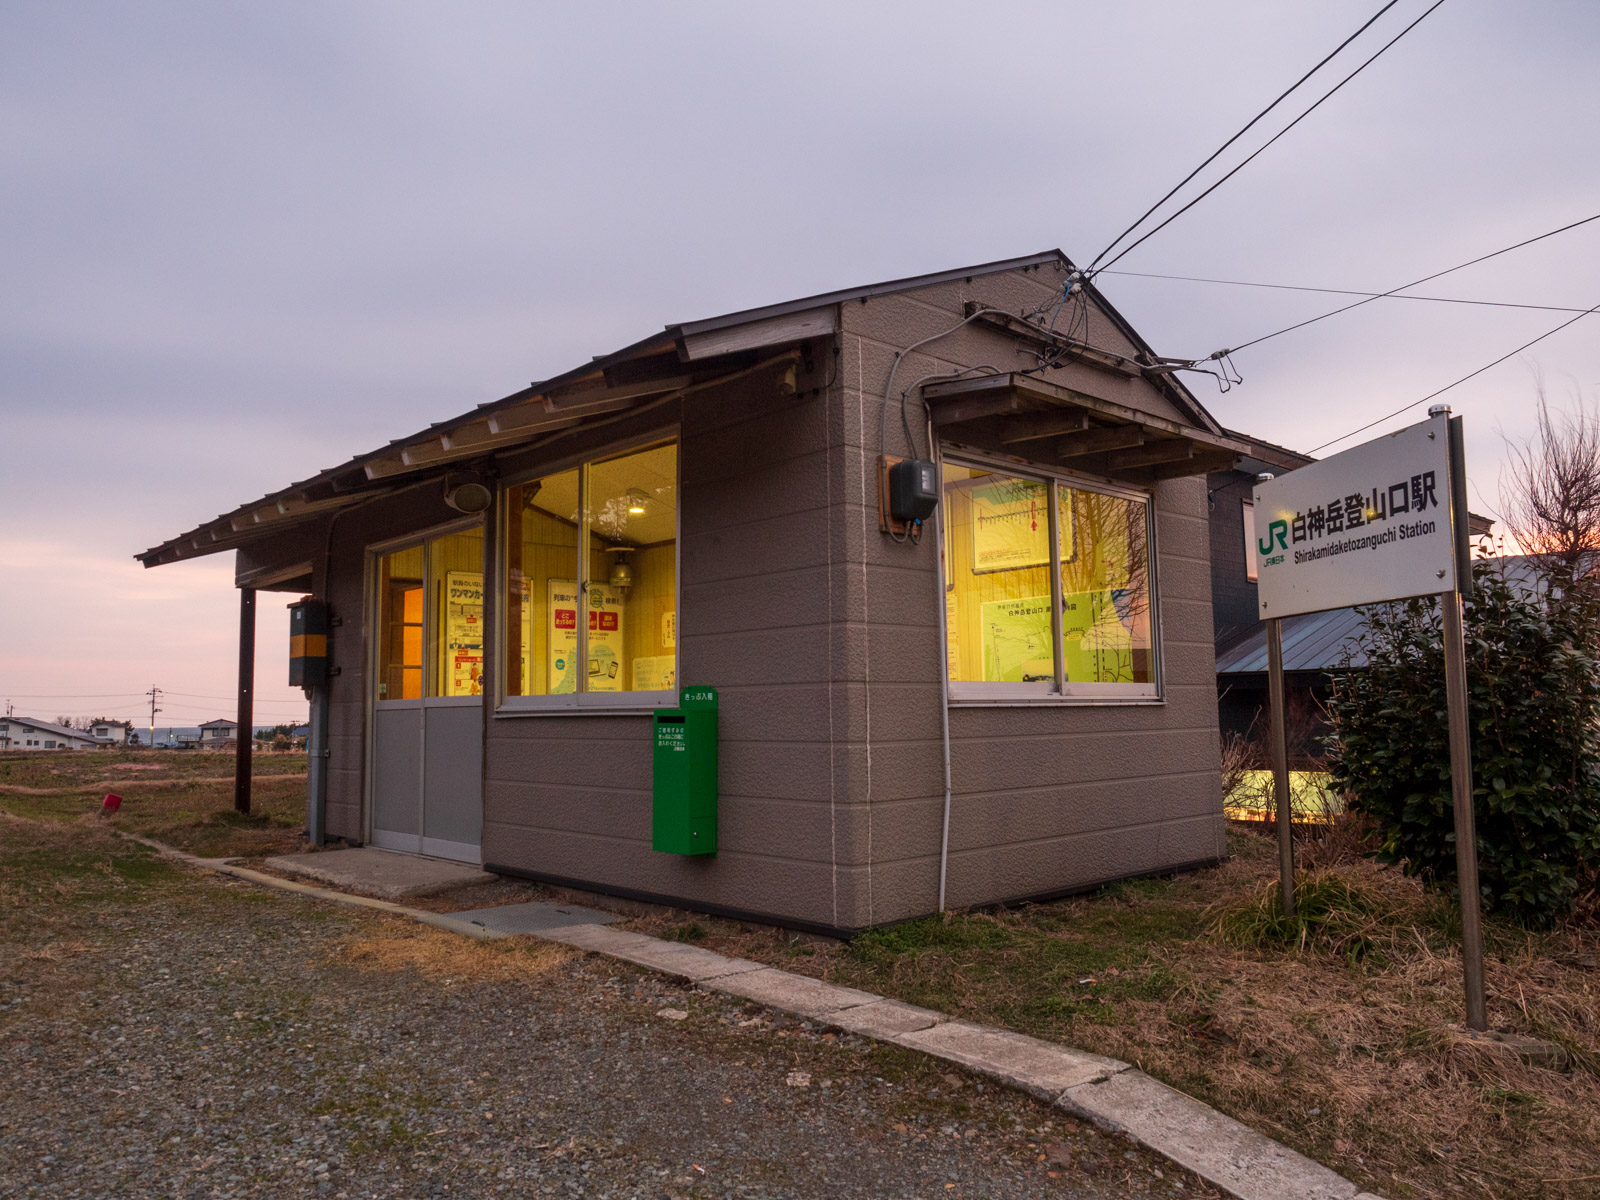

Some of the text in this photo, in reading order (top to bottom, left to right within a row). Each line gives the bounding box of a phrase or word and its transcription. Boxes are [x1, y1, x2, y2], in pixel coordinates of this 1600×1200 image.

[1291, 470, 1438, 544] 白神岳登山口駅
[1258, 519, 1288, 556] JR
[1294, 519, 1436, 565] Shirakamidaketozanguchi Station
[1263, 554, 1285, 568] JR東日本
